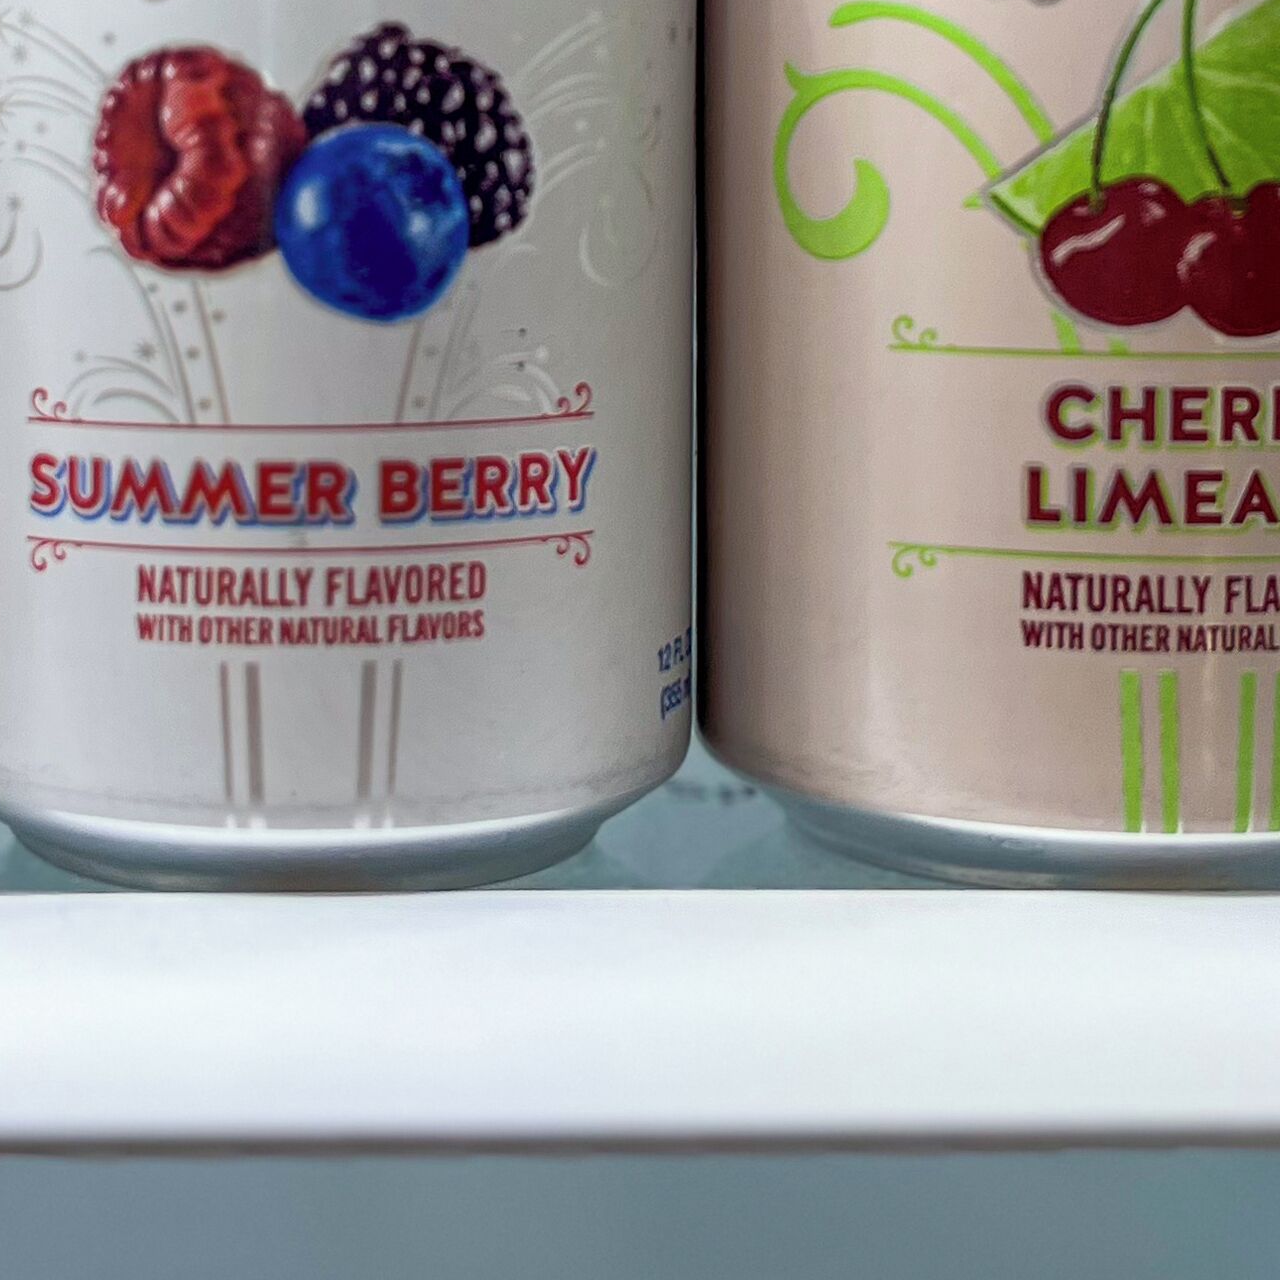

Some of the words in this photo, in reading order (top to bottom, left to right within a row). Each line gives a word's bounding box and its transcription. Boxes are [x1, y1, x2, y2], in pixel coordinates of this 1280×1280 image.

[28, 451, 355, 526] SUMMER
[378, 447, 597, 523] BERRY
[137, 564, 314, 608] NATURALLY
[325, 560, 487, 608] FLAVORED
[1022, 570, 1211, 615] NATURALLY
[137, 612, 193, 642] WITH
[198, 613, 274, 646] OTHER
[278, 614, 382, 646] NATURAL
[387, 609, 486, 644] FLAVORS
[1020, 619, 1084, 651] WITH
[1090, 622, 1171, 653] OTHER
[1176, 622, 1280, 653] NATURAL
